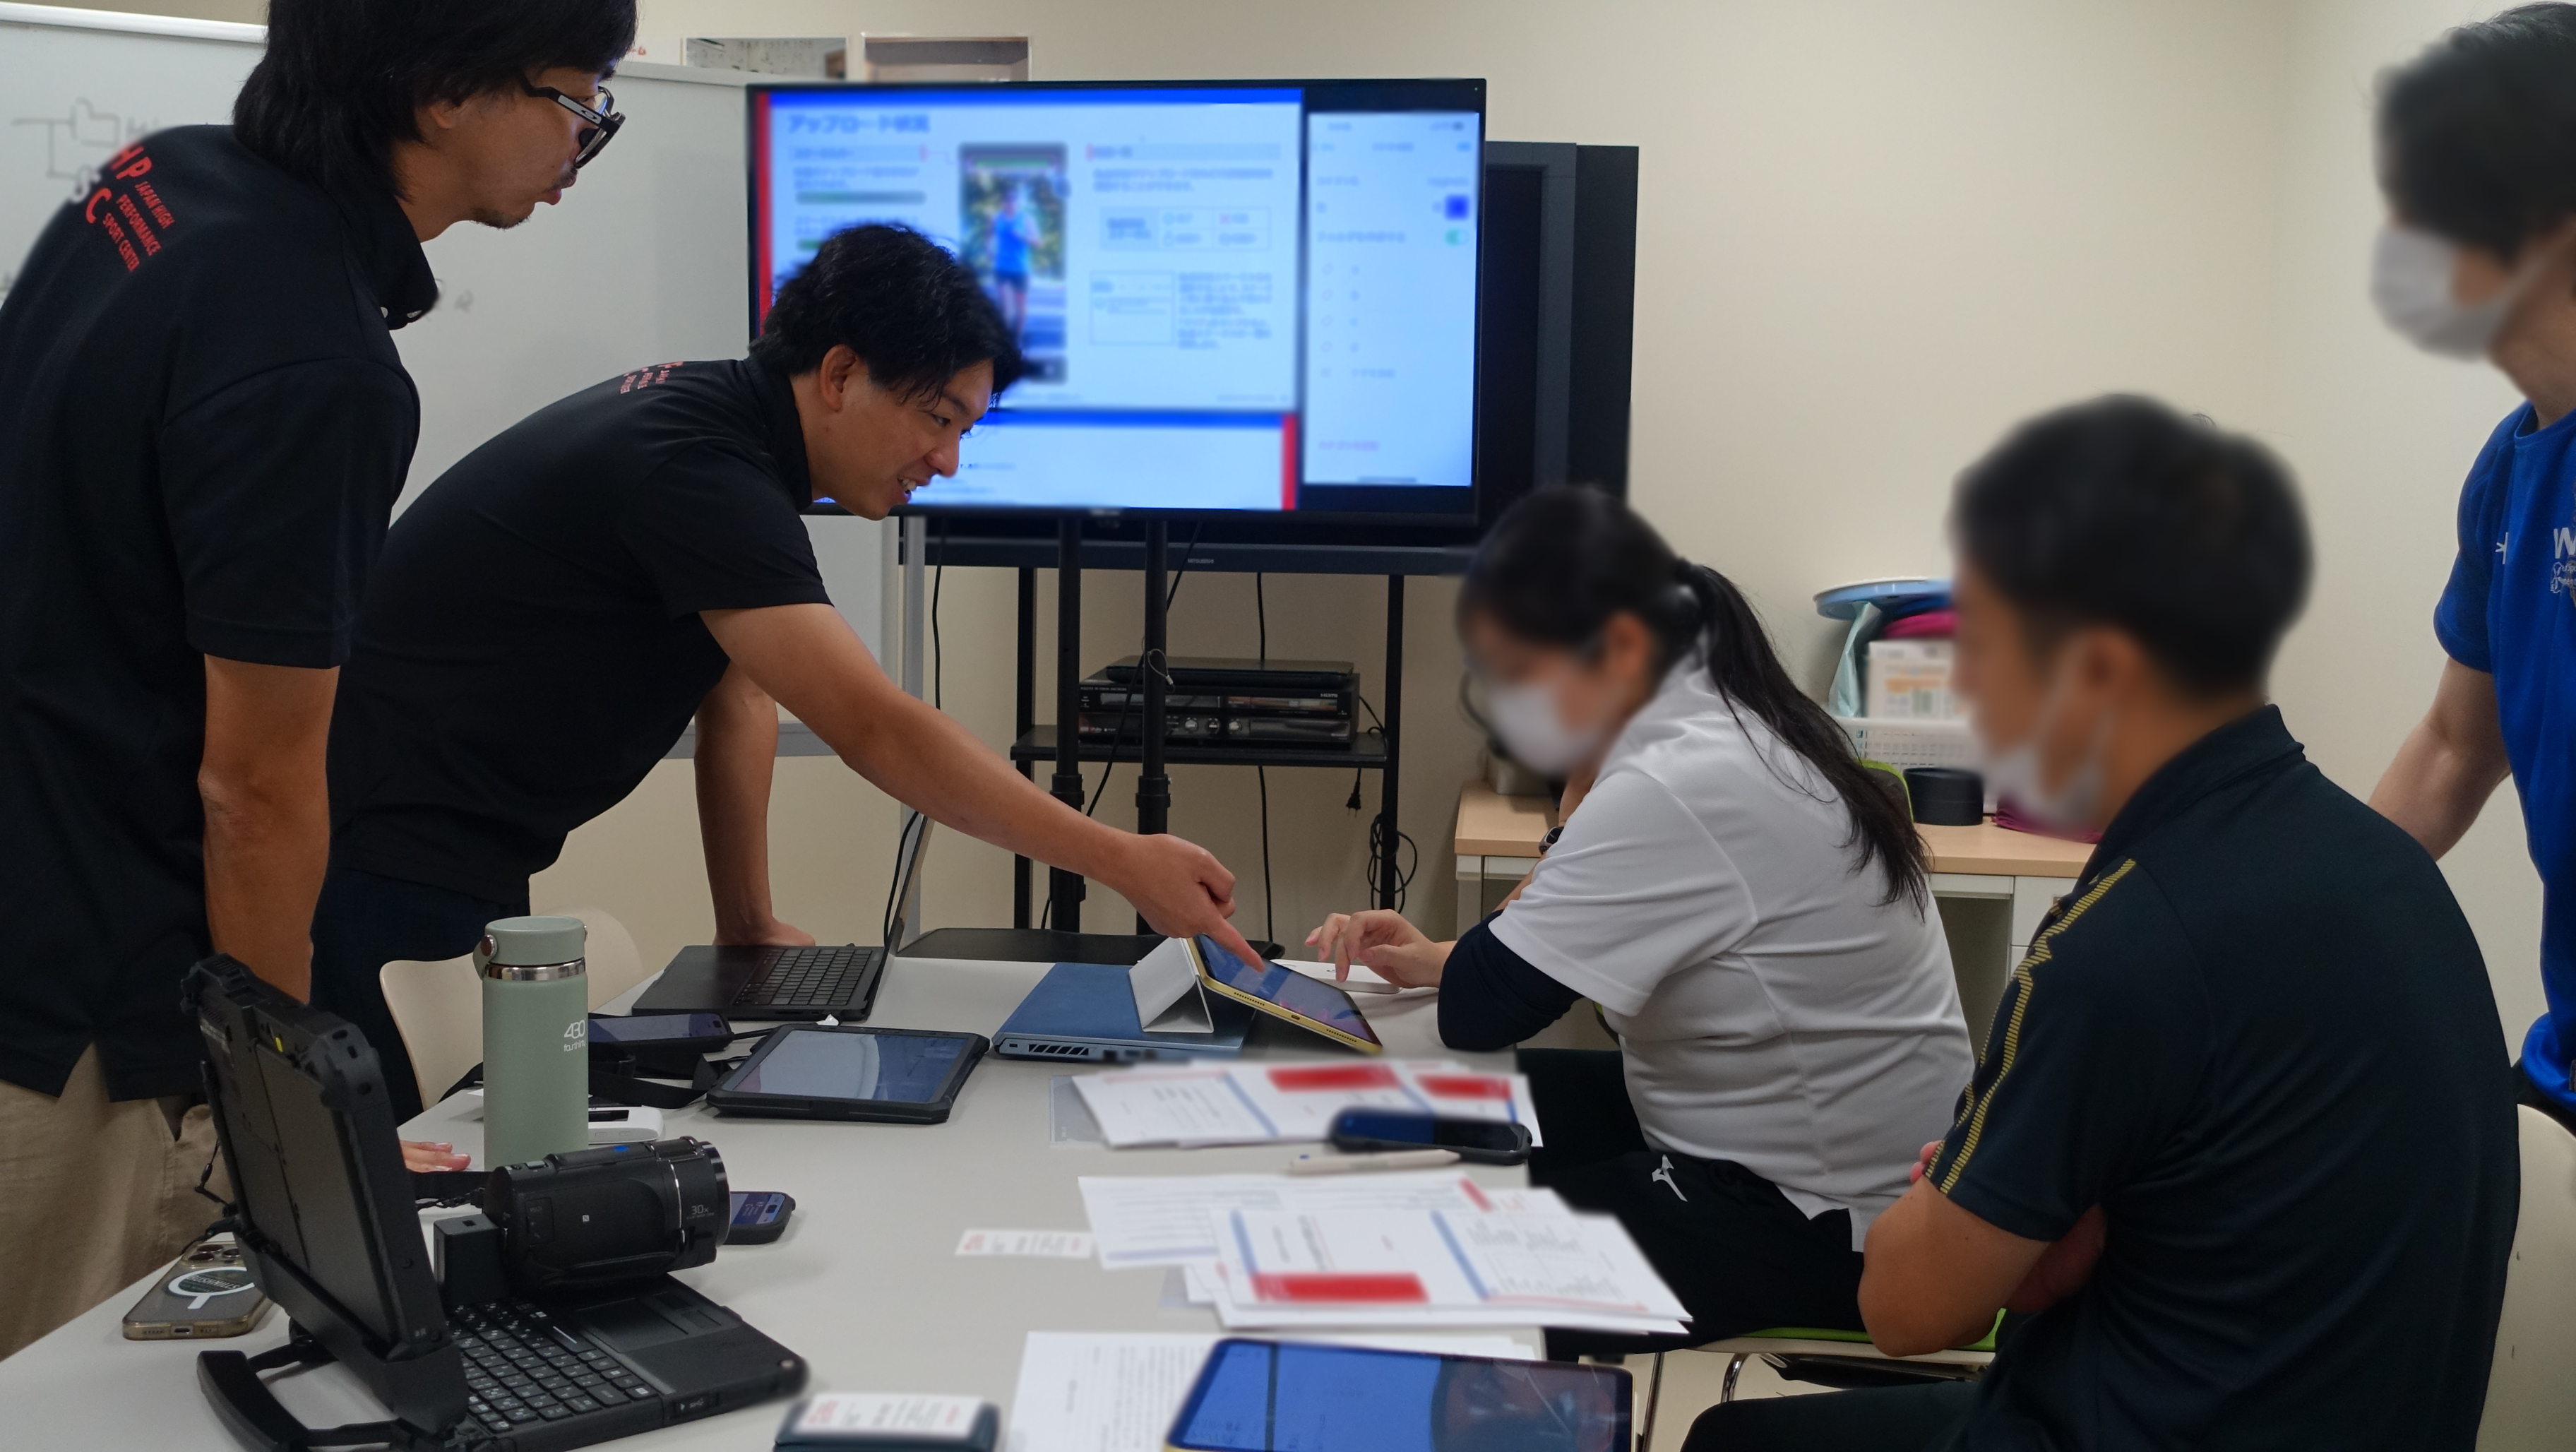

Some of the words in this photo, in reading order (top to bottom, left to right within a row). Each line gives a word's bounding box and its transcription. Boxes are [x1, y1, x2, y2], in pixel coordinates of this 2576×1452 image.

[116, 194, 162, 256] PERFORMANCE
[134, 181, 162, 209] JAPAN
[151, 203, 175, 230] HIGH
[102, 212, 125, 244] SPORT
[118, 239, 141, 273] CENTER
